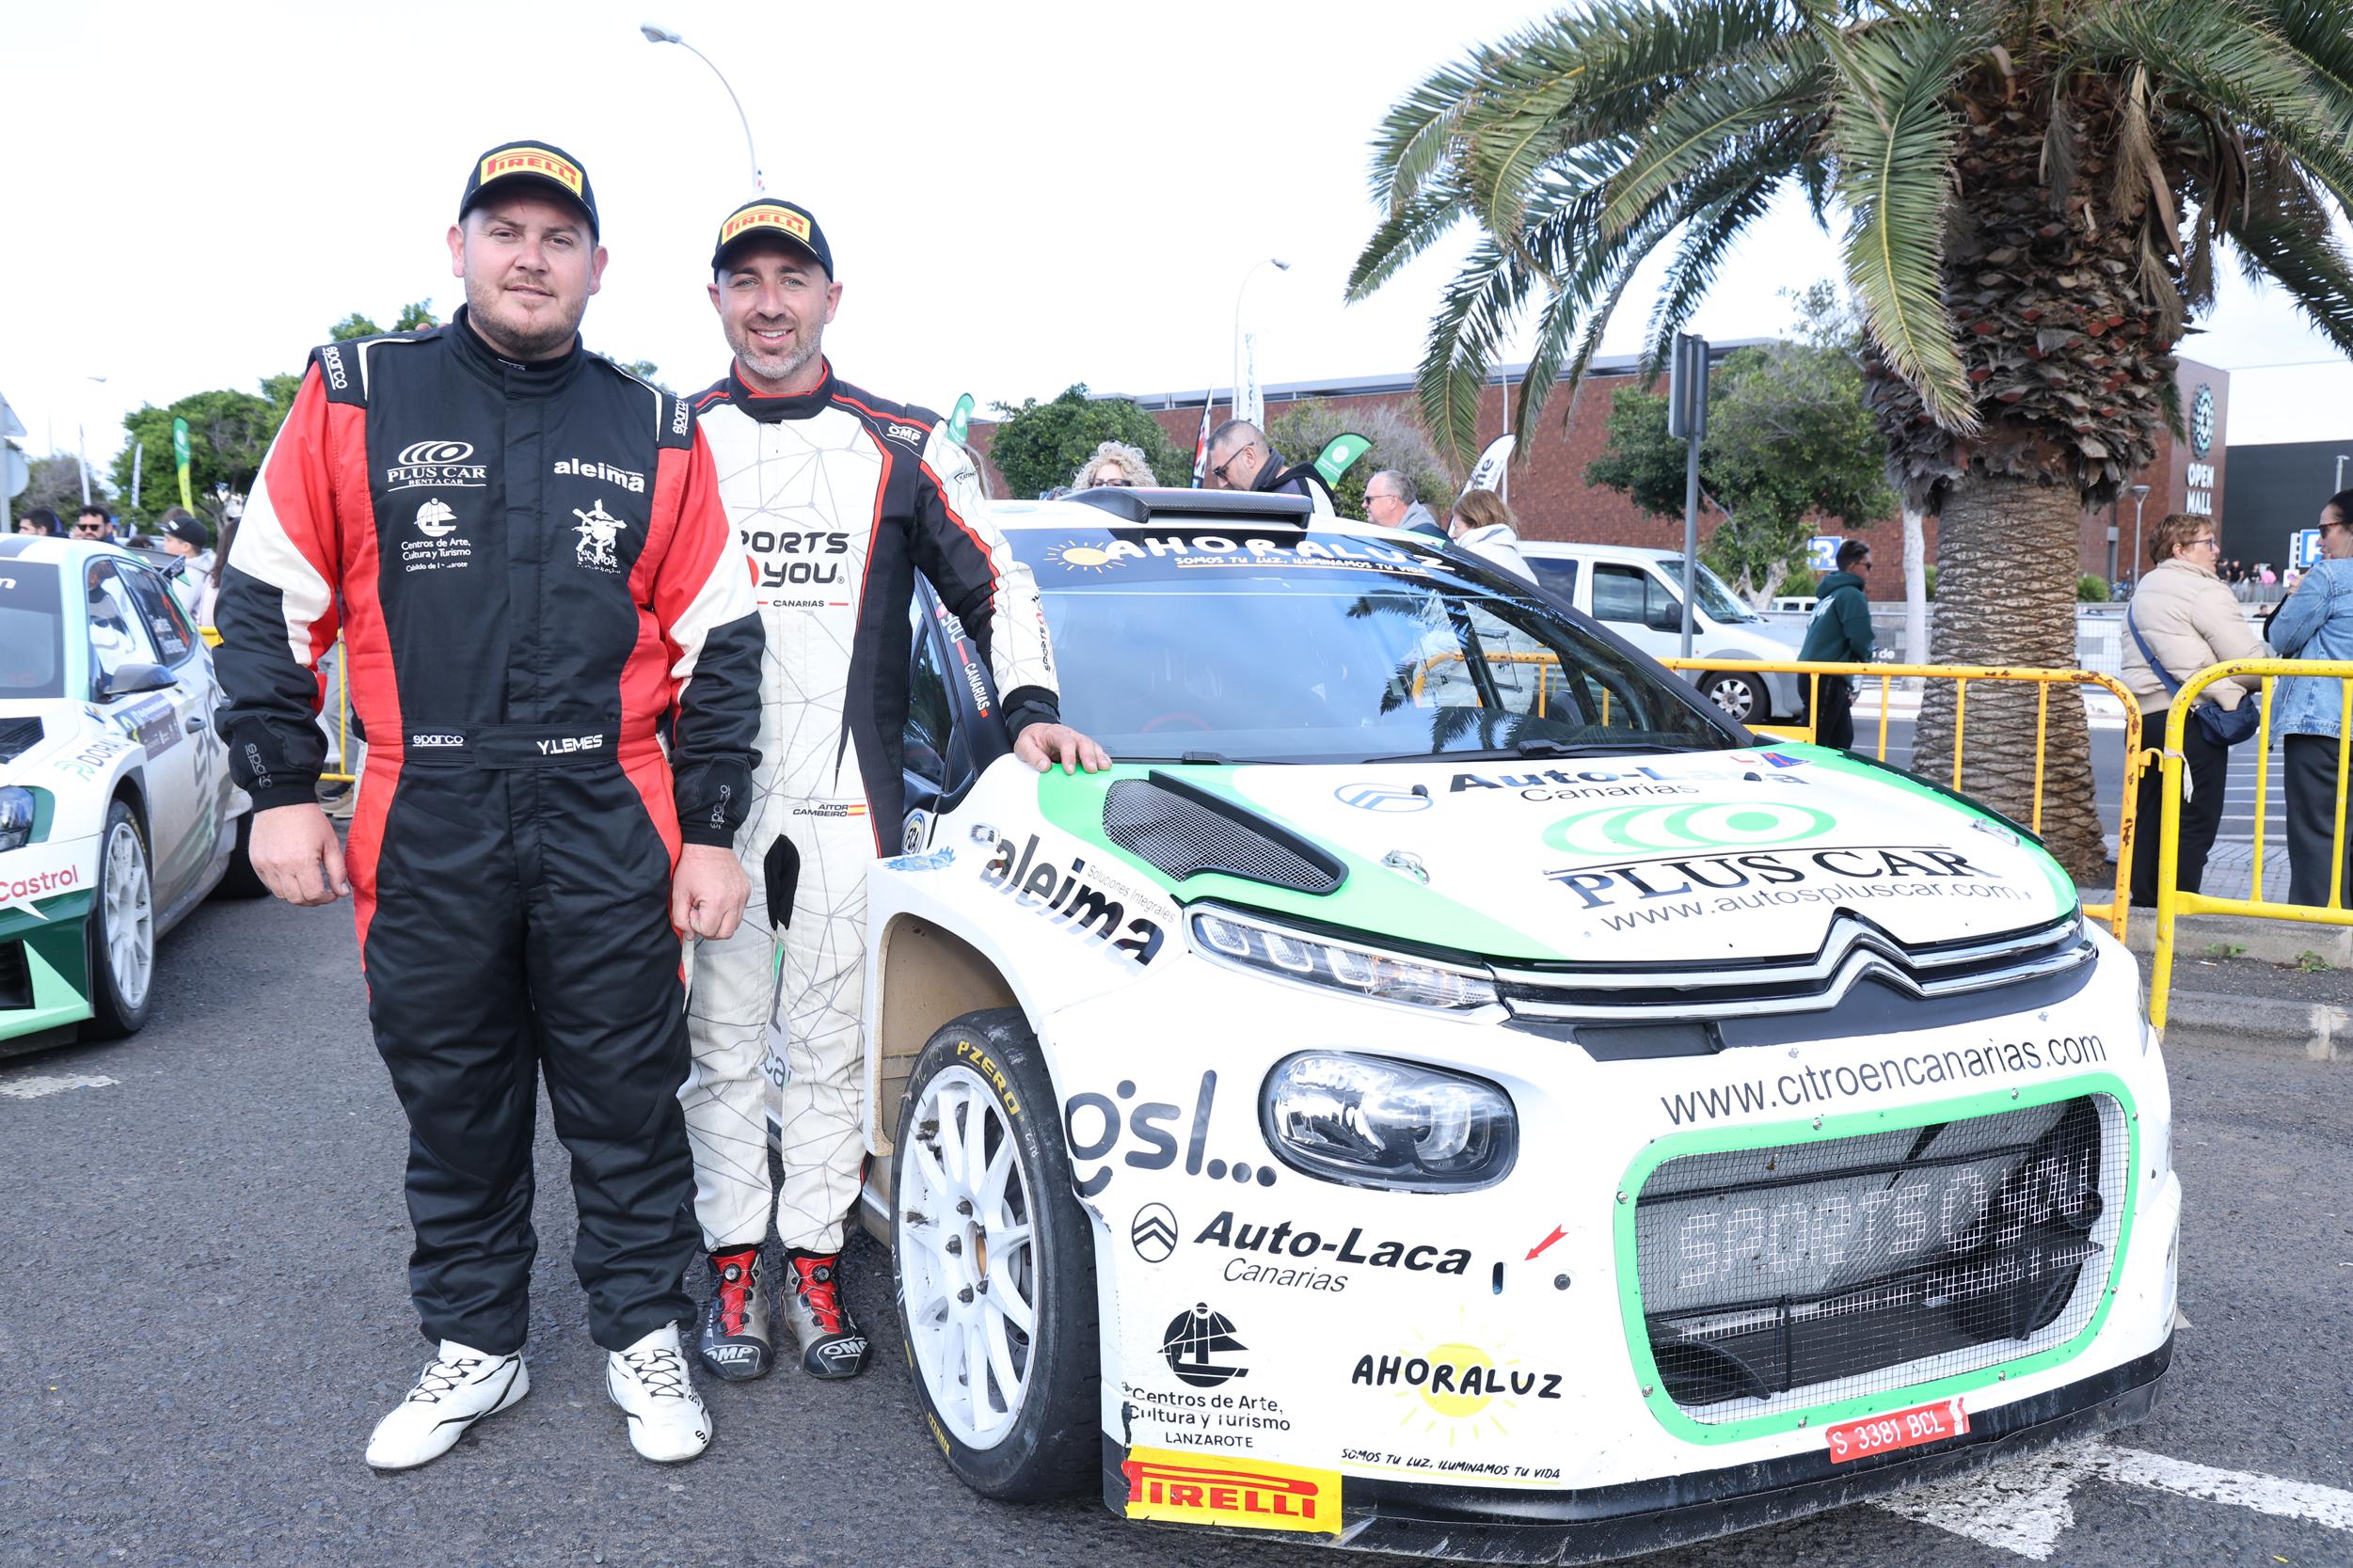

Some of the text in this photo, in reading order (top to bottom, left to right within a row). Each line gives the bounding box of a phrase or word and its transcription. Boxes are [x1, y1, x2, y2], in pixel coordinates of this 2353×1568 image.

[486, 151, 577, 186] PIRELLI
[725, 208, 804, 238] PIRELLI
[321, 346, 349, 389] sparco
[672, 399, 689, 436] sparco
[887, 424, 922, 443] OMP
[387, 467, 486, 483] PLUS CAR
[554, 458, 644, 493] aleima
[2187, 463, 2215, 488] OPEN
[2186, 491, 2212, 515] MALL
[402, 538, 470, 551] Centros de Arte,
[403, 550, 430, 561] Cultura
[439, 548, 471, 558] Turismo
[740, 530, 850, 554] ORTS
[1105, 535, 1455, 571] AHORALUZ
[1174, 557, 1225, 565] SOMOS
[1228, 557, 1248, 565] TU
[1293, 558, 1373, 570] ILUMINAMOS
[1377, 562, 1394, 571] TU
[1399, 564, 1427, 575] VIDA
[963, 662, 991, 711] CANARIAS
[412, 735, 464, 747] sparco
[536, 734, 603, 755] Y.LEMES
[1520, 784, 1700, 801] Canarias
[792, 809, 848, 817] CAMBEIRO
[1087, 864, 1176, 924] Soluciones Integrales
[1548, 850, 2002, 910] PLUS CAR
[979, 833, 1165, 977] aleima
[1600, 879, 2023, 932] www.autospluscar.com
[1661, 1034, 2107, 1126] www.citroencanarias.com
[1193, 1211, 1472, 1276] Auto-Laca
[1676, 1183, 1930, 1289] SPORTS
[1223, 1258, 1349, 1292] Canarias
[1351, 1354, 1563, 1399] AHORALUZ
[1132, 1387, 1283, 1415] Centros de Arte,
[1200, 1414, 1211, 1429] y
[1832, 1410, 1946, 1455] S 3381 BCL
[1165, 1432, 1253, 1448] LANZAROTE
[1342, 1449, 1381, 1463] SOMOS
[1386, 1454, 1401, 1465] TU
[1438, 1461, 1510, 1476] ILUMINAMOS
[1514, 1466, 1528, 1477] TU
[1534, 1468, 1561, 1479] VIDA
[1121, 1459, 1319, 1519] PIRELLI
